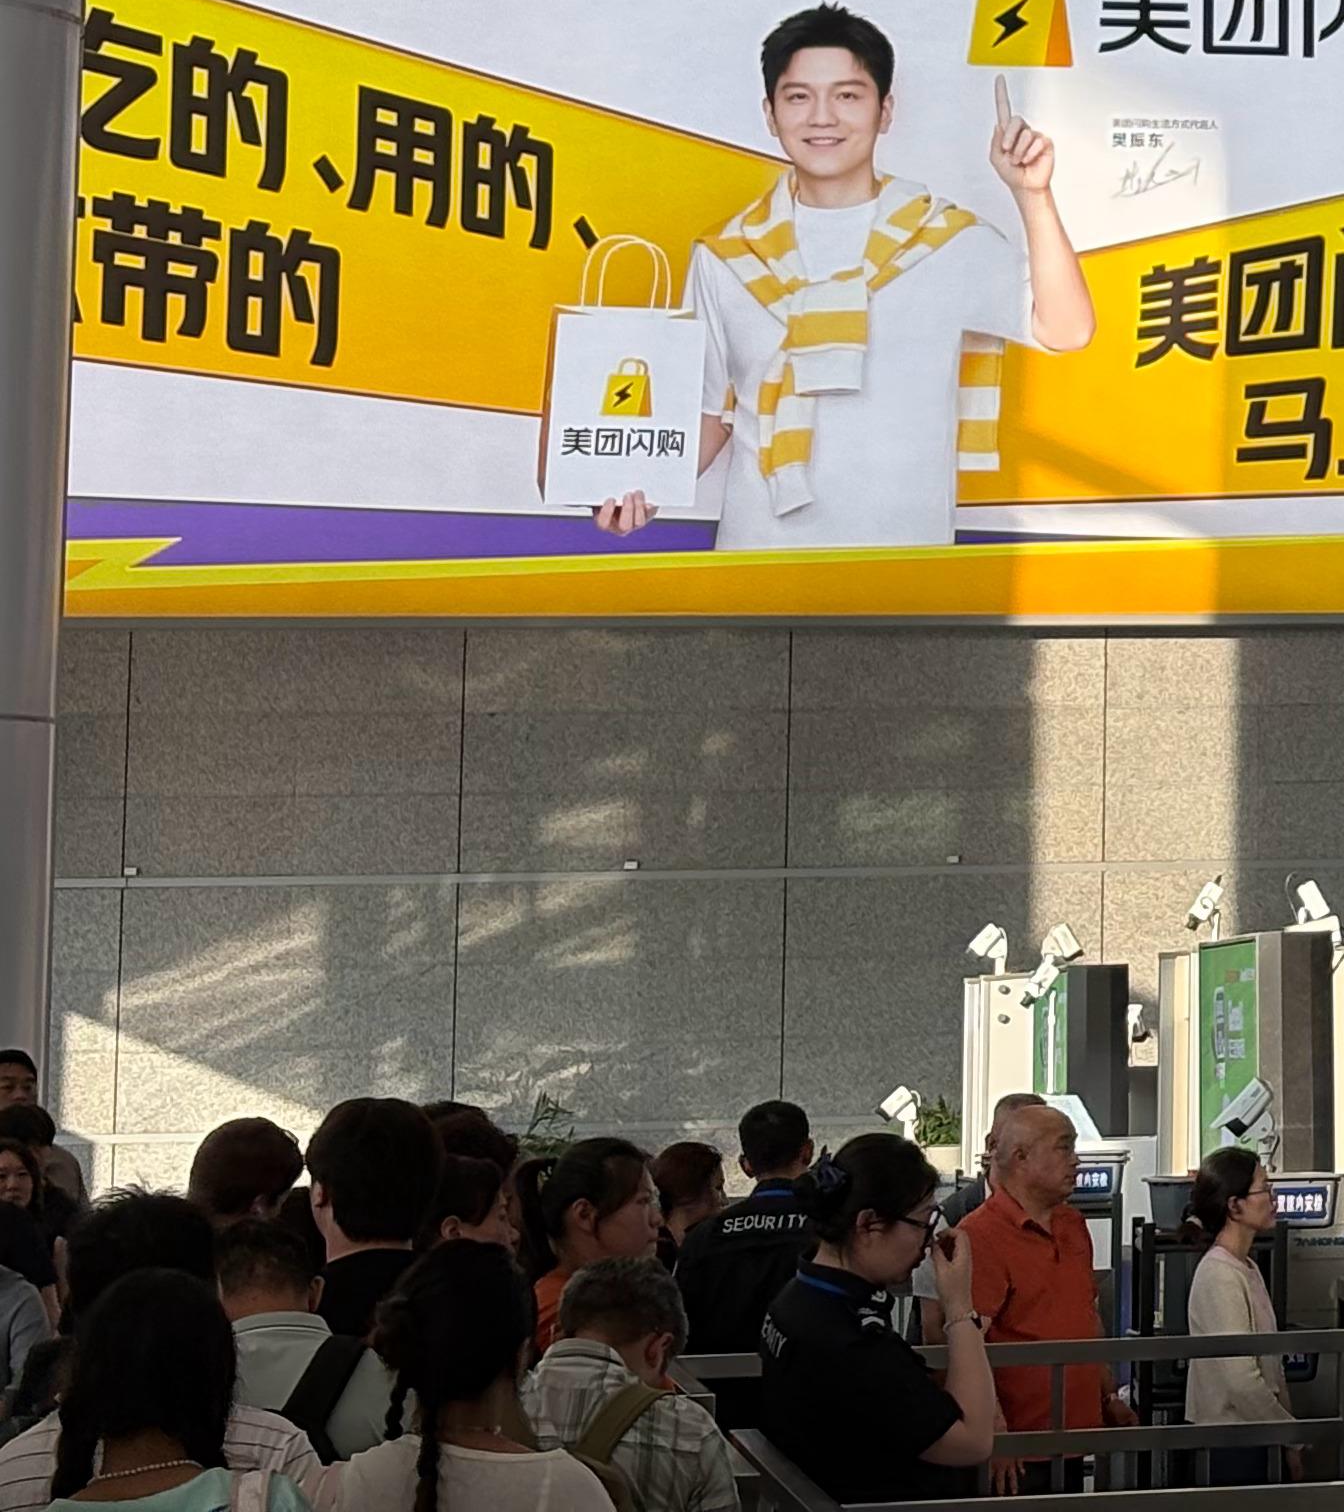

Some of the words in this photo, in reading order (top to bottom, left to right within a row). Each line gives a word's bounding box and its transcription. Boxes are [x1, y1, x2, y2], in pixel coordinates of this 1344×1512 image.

[72, 191, 342, 367] 带的
[561, 427, 686, 459] 美团闪购
[722, 1213, 808, 1235] SECURITY
